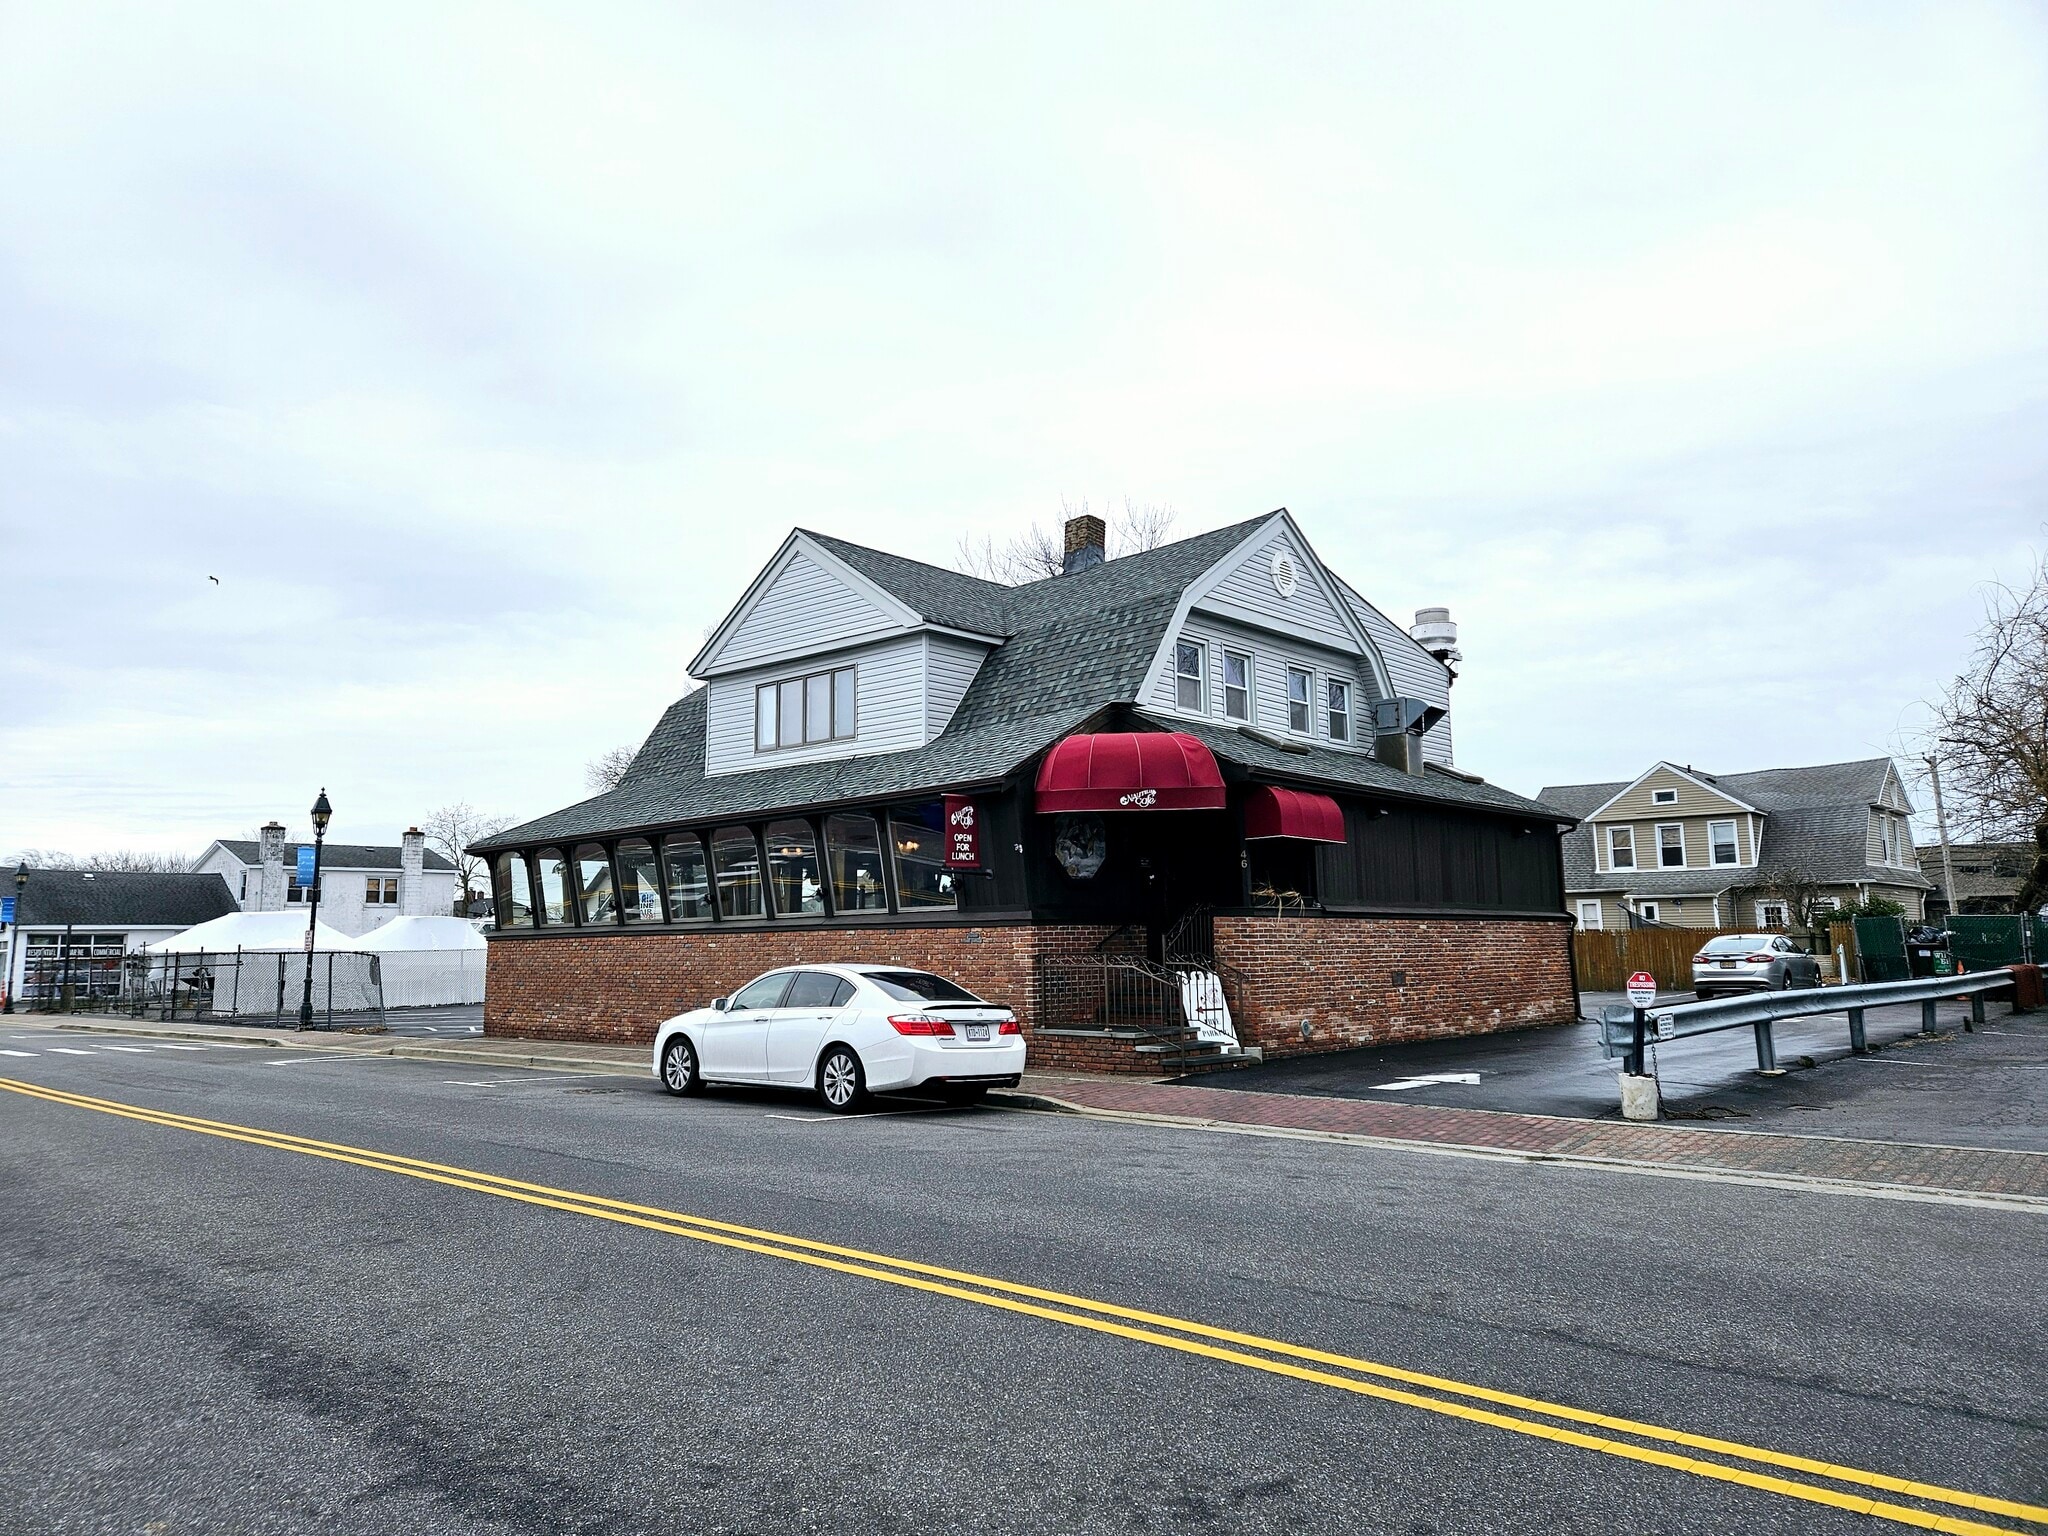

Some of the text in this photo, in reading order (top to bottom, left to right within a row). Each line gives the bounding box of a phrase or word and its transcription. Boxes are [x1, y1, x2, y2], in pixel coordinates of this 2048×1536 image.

[954, 833, 973, 842] OPEN
[956, 843, 970, 852] FOR
[951, 852, 975, 861] LUNCH
[27, 948, 56, 956] RESIDNTIAL
[94, 948, 121, 956] COMMERCIAL
